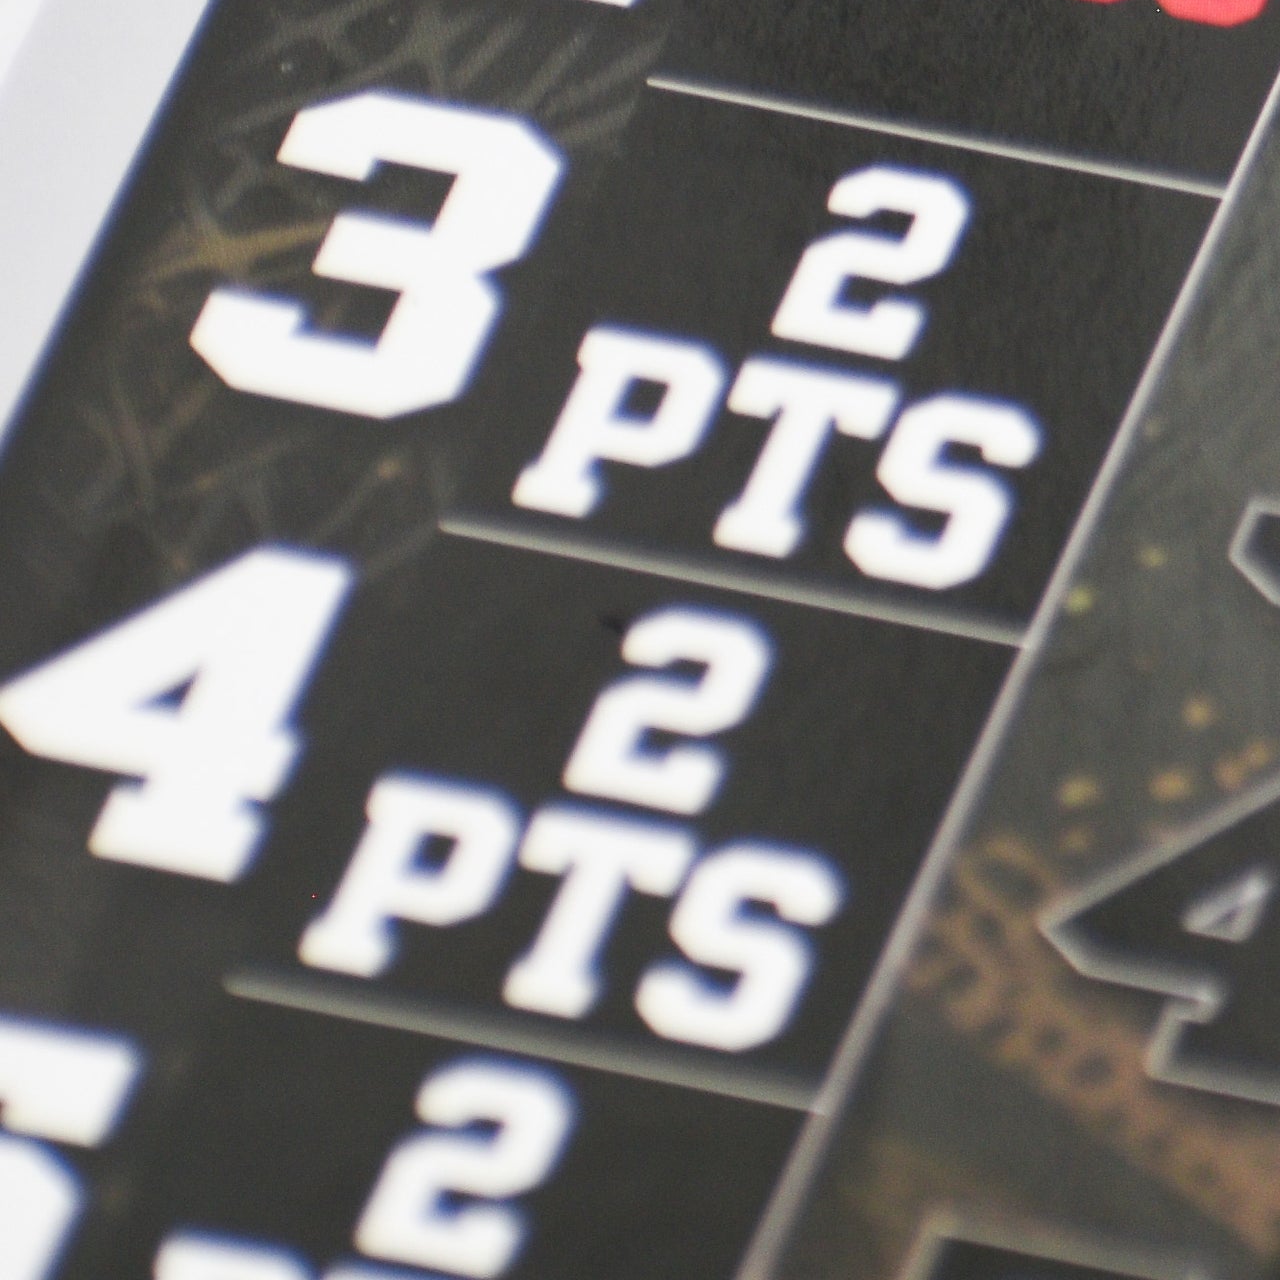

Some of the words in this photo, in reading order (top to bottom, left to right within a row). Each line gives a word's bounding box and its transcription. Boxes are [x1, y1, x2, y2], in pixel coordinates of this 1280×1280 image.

[191, 92, 560, 418] 3
[772, 168, 966, 359] 2
[511, 328, 1039, 590] PTS
[0, 550, 348, 881] 4
[566, 612, 766, 813] 2
[299, 772, 845, 1053] PTS
[360, 1067, 567, 1278] 2
